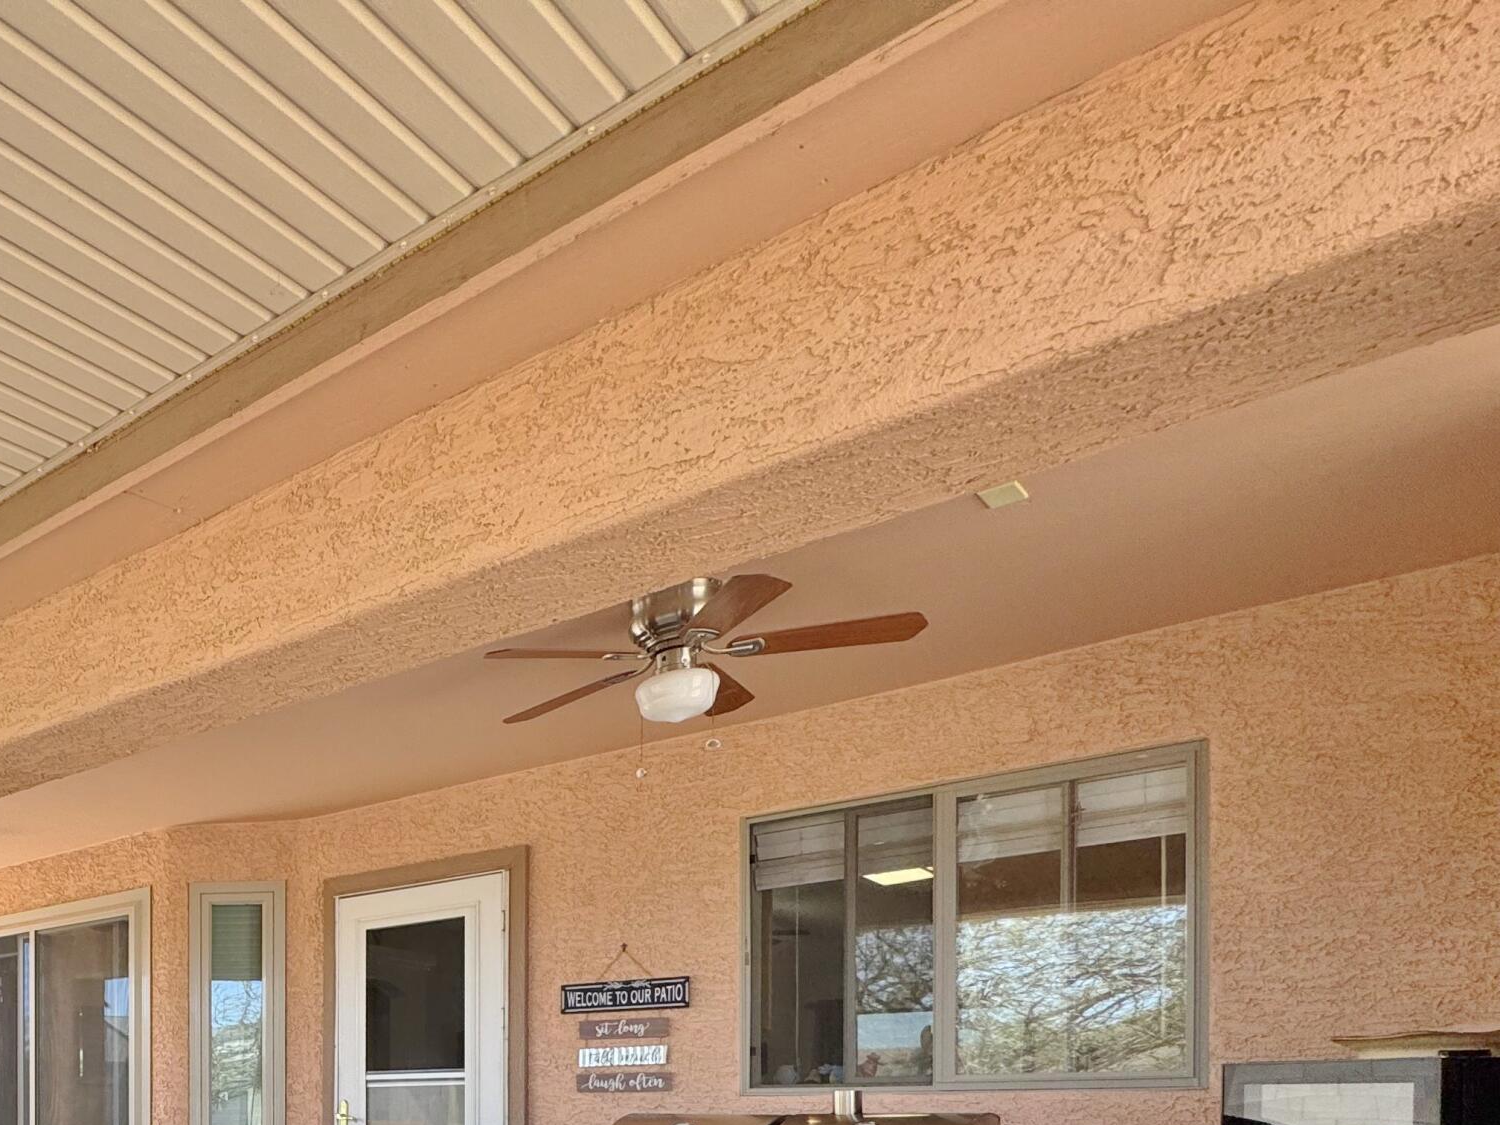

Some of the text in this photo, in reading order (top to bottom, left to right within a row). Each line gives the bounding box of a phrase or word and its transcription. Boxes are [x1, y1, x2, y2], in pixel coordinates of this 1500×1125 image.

[567, 983, 683, 1007] WELCOME TO OUR PATIO
[595, 1019, 650, 1037] sit long
[581, 1073, 665, 1091] laugh often
